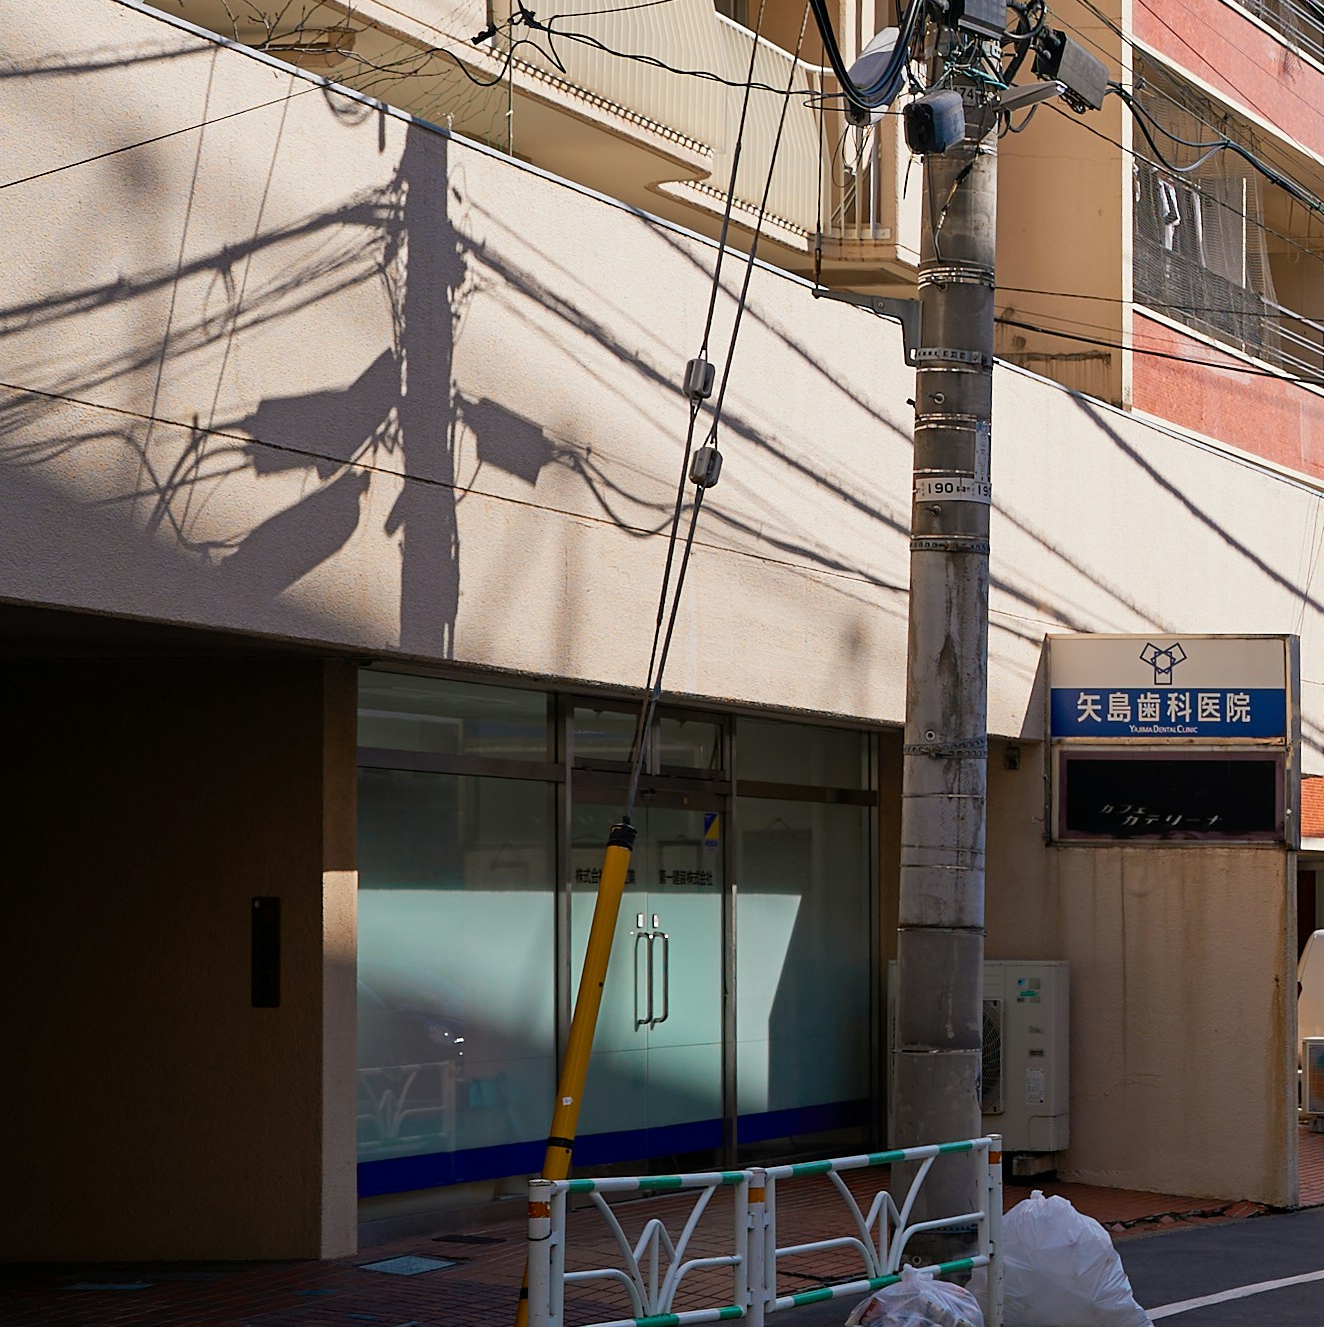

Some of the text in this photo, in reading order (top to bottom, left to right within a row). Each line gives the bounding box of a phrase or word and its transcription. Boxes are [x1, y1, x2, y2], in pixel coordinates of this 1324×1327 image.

[928, 483, 954, 494] 190
[1076, 691, 1251, 723] 矢島歯科医院
[1101, 804, 1147, 814] カフェ
